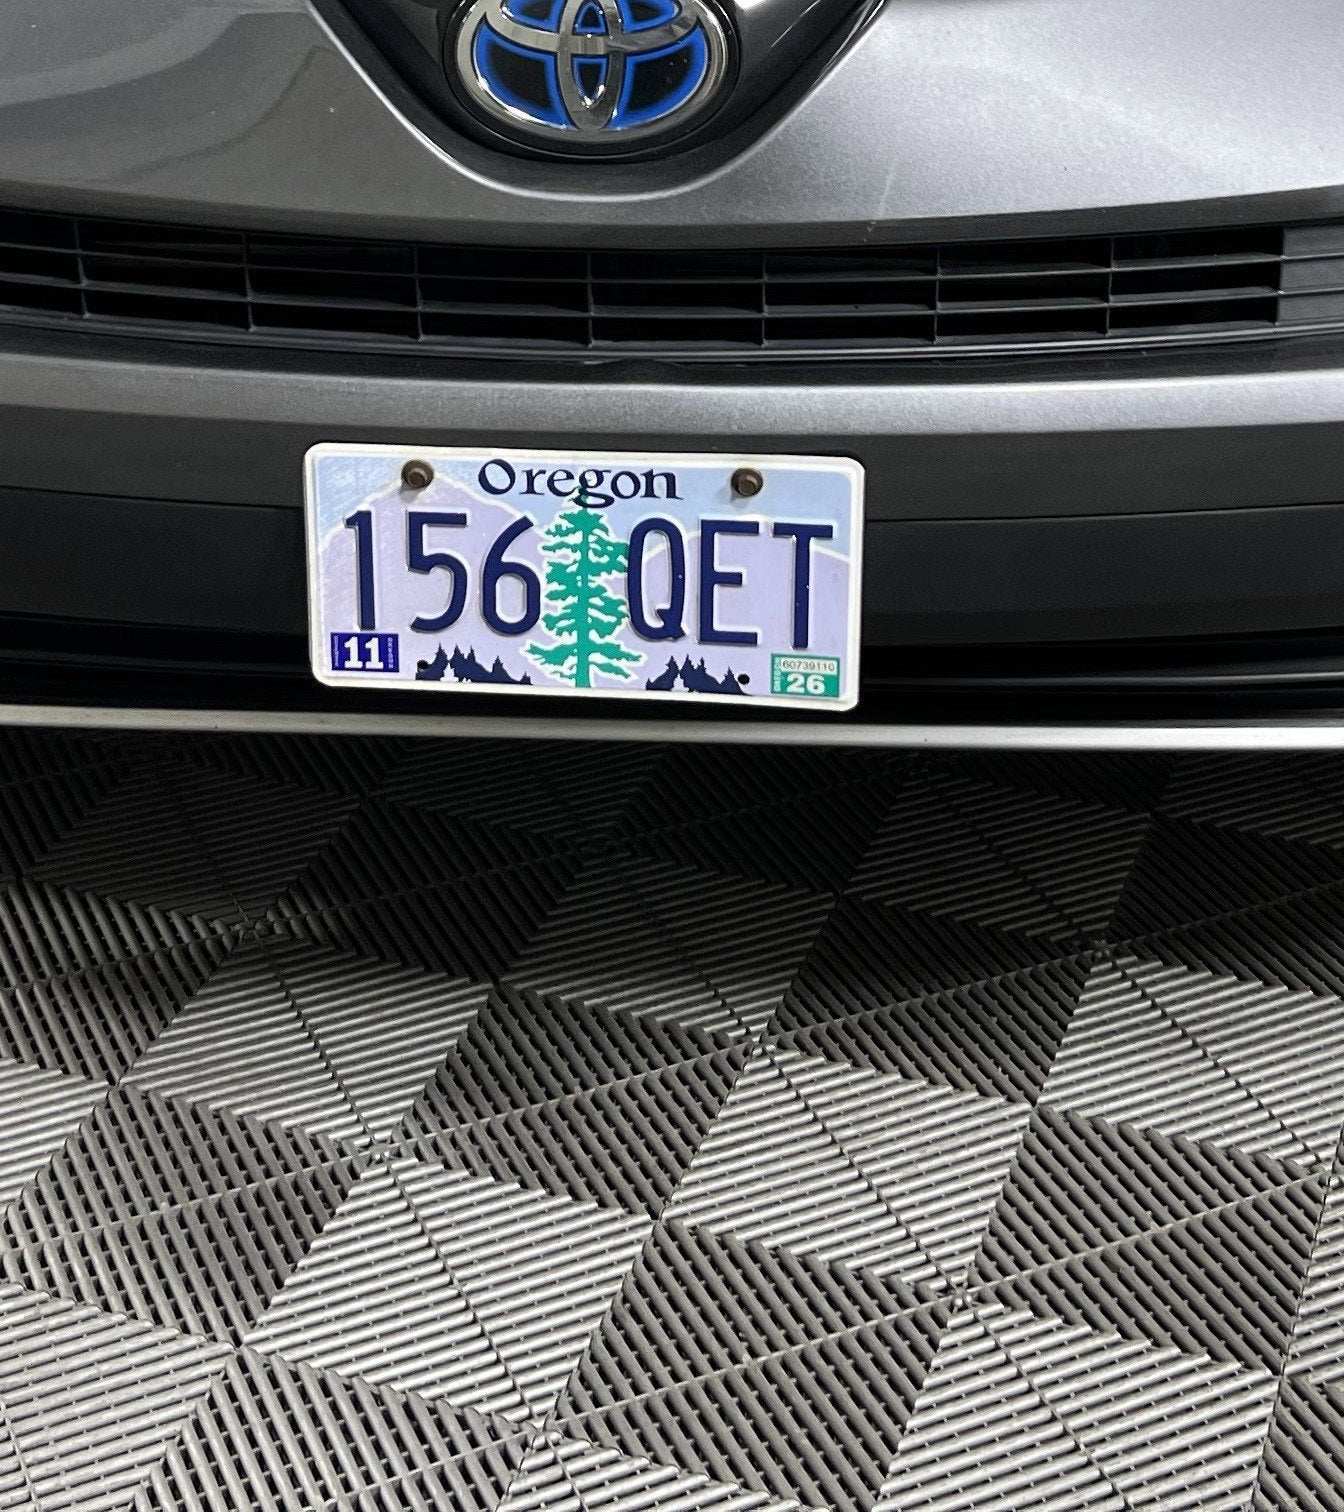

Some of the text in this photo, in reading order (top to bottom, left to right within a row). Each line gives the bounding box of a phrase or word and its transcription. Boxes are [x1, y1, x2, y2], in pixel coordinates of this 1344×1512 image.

[477, 458, 684, 508] Oregon
[344, 510, 834, 648] 156 QET
[344, 636, 384, 669] 11
[786, 673, 826, 695] 26
